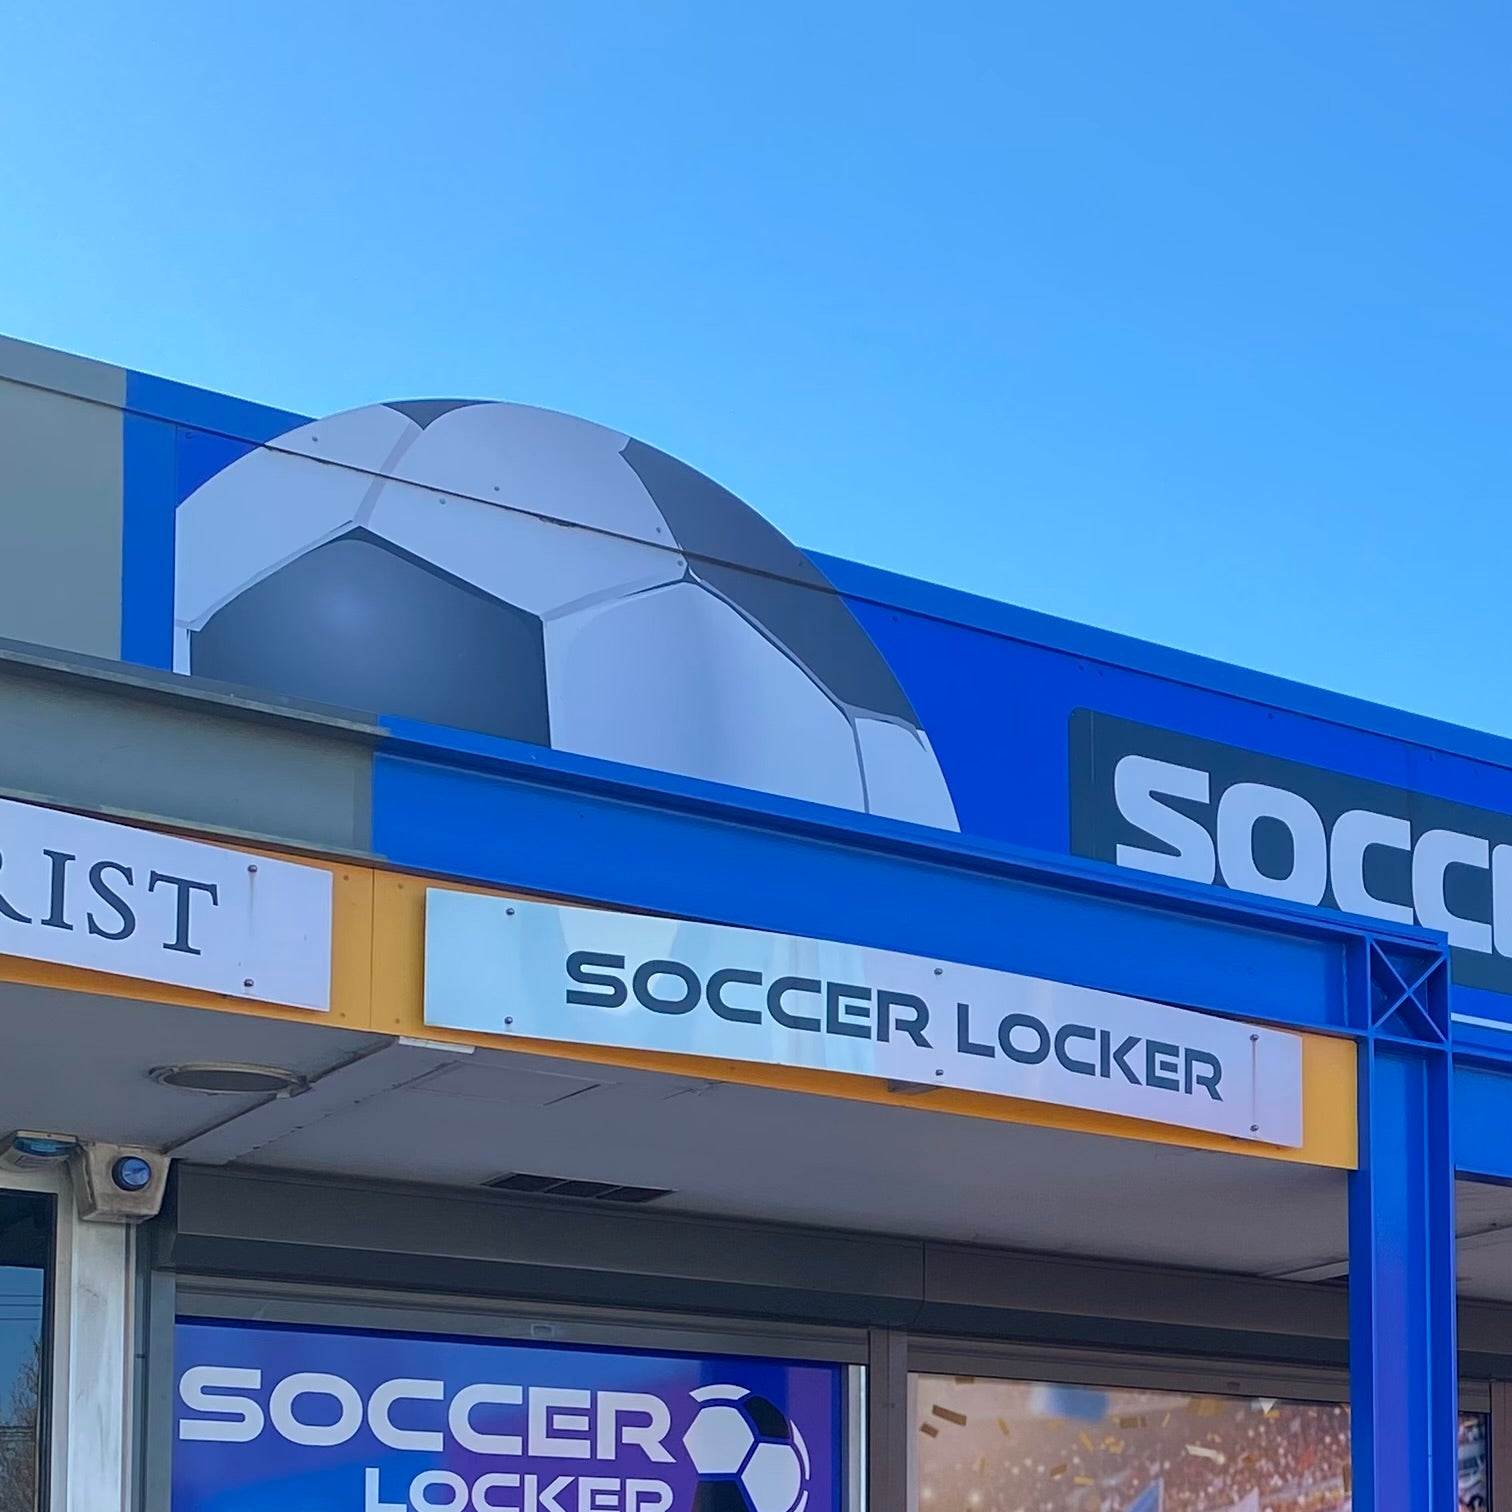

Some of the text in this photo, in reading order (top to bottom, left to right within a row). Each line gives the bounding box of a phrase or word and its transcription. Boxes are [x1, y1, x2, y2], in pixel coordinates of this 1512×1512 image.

[566, 950, 1223, 1101] SOCCER LOCKER
[179, 1365, 677, 1463] SOCCER
